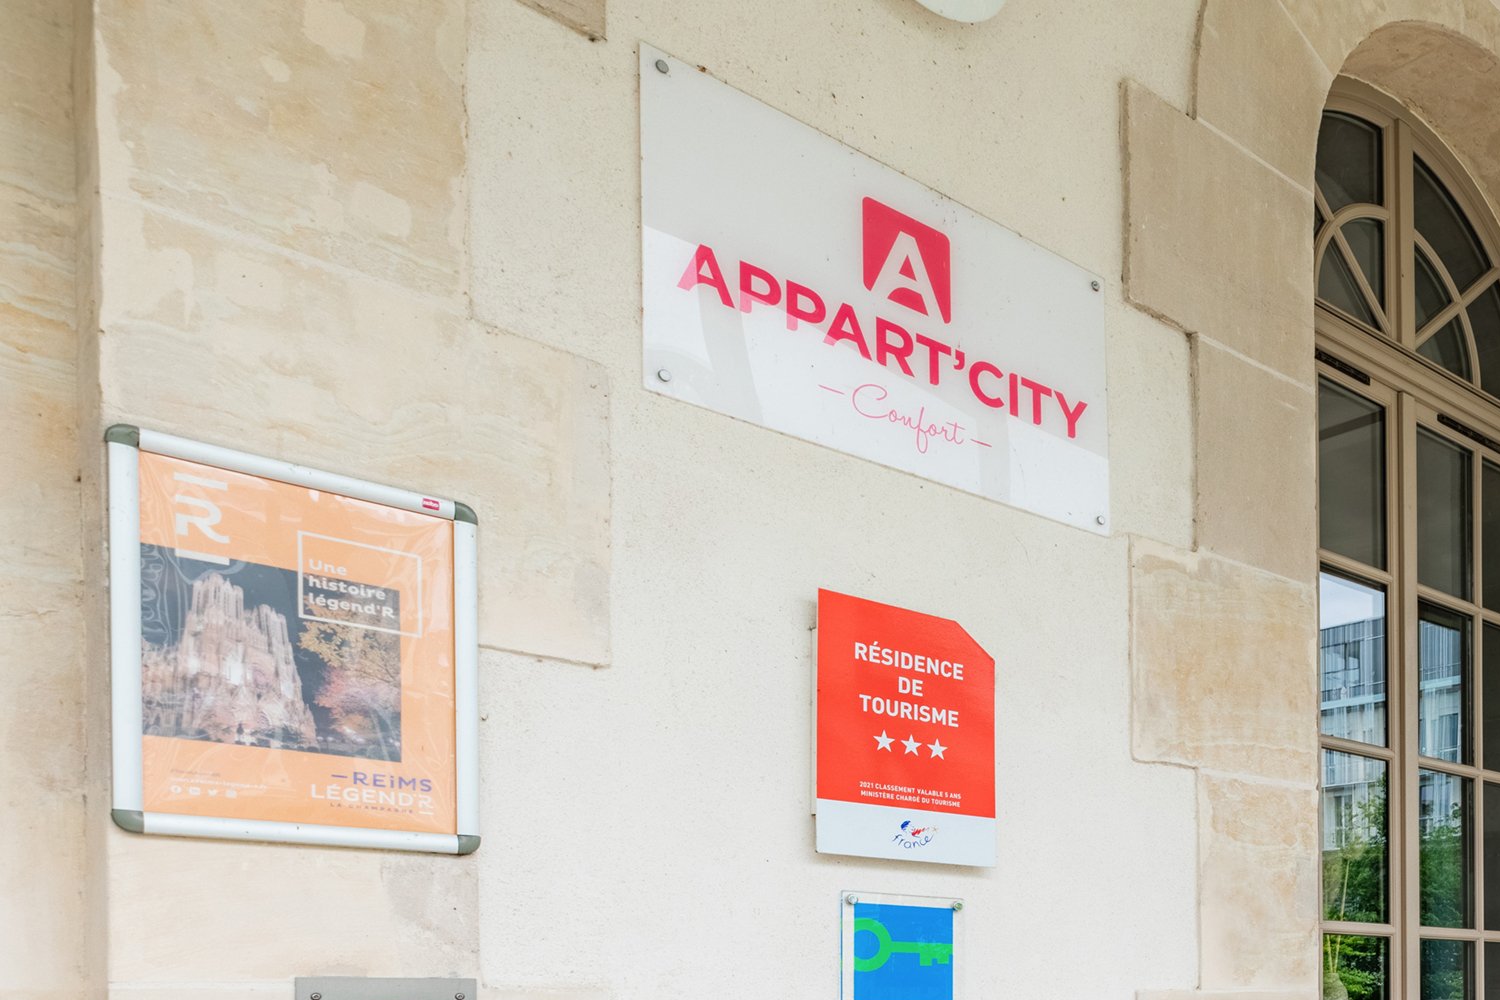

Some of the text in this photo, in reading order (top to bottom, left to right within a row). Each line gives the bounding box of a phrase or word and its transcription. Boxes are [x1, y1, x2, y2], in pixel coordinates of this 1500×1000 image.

[677, 243, 1088, 439] APPART'CITY
[851, 383, 966, 453] Confort
[308, 558, 348, 576] Une
[308, 575, 386, 600] histoire
[308, 592, 396, 619] légend'R
[854, 641, 964, 681] RÉSIDENCE
[898, 676, 924, 697] DE
[859, 694, 959, 728] TOURISME
[859, 781, 874, 789] 2021
[875, 783, 915, 794] CLASSEMENT
[917, 788, 943, 798] VALABLE
[949, 792, 961, 800] ANS
[860, 790, 895, 800] MINISTÈRE
[931, 798, 961, 808] TOURISME
